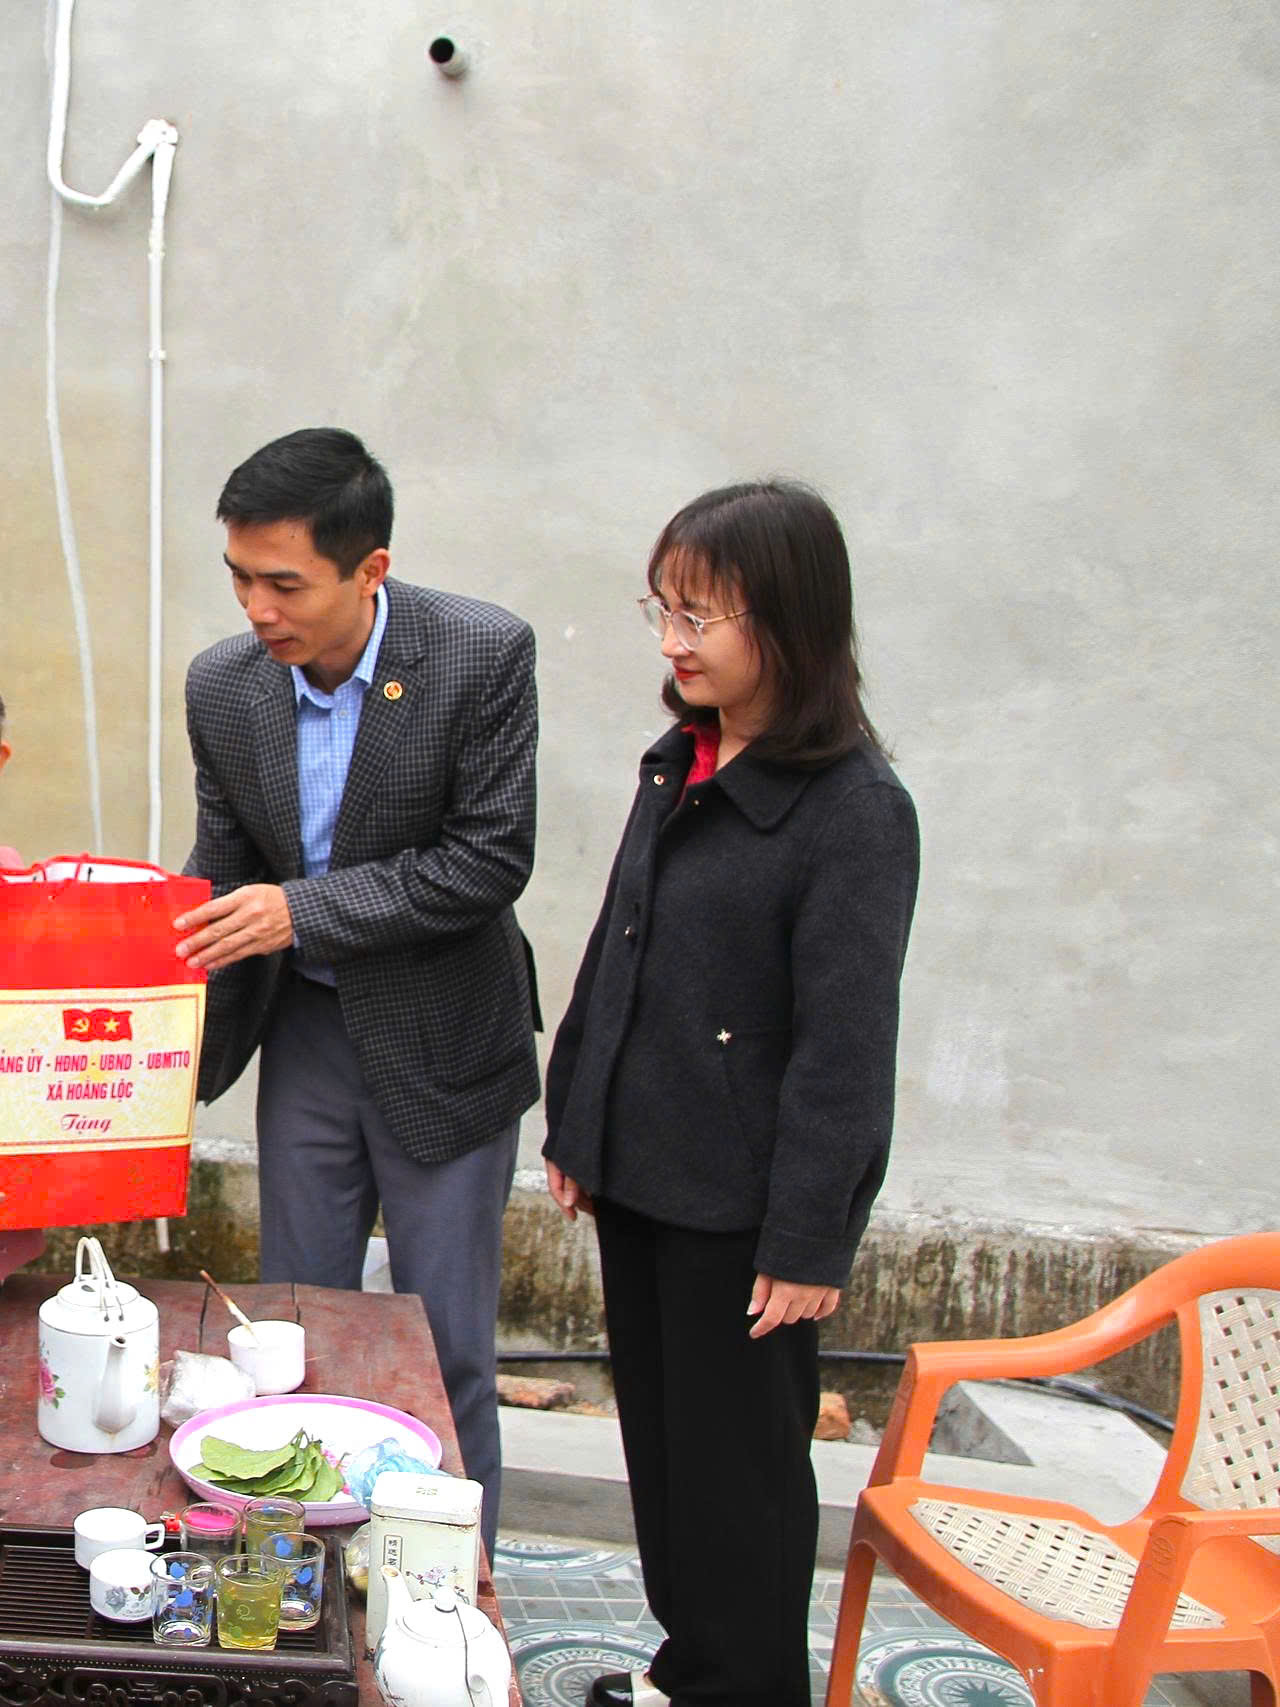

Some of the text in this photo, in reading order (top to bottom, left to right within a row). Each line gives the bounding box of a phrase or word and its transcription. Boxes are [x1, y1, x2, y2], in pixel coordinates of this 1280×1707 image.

[27, 1048, 44, 1073] ỦY
[54, 1055, 88, 1072] HĐND
[100, 1053, 132, 1071] UBND
[147, 1050, 190, 1070] UBMTTQ
[46, 1080, 63, 1101] XÃ
[111, 1078, 134, 1103] LỘC
[61, 1113, 112, 1135] Tặng
